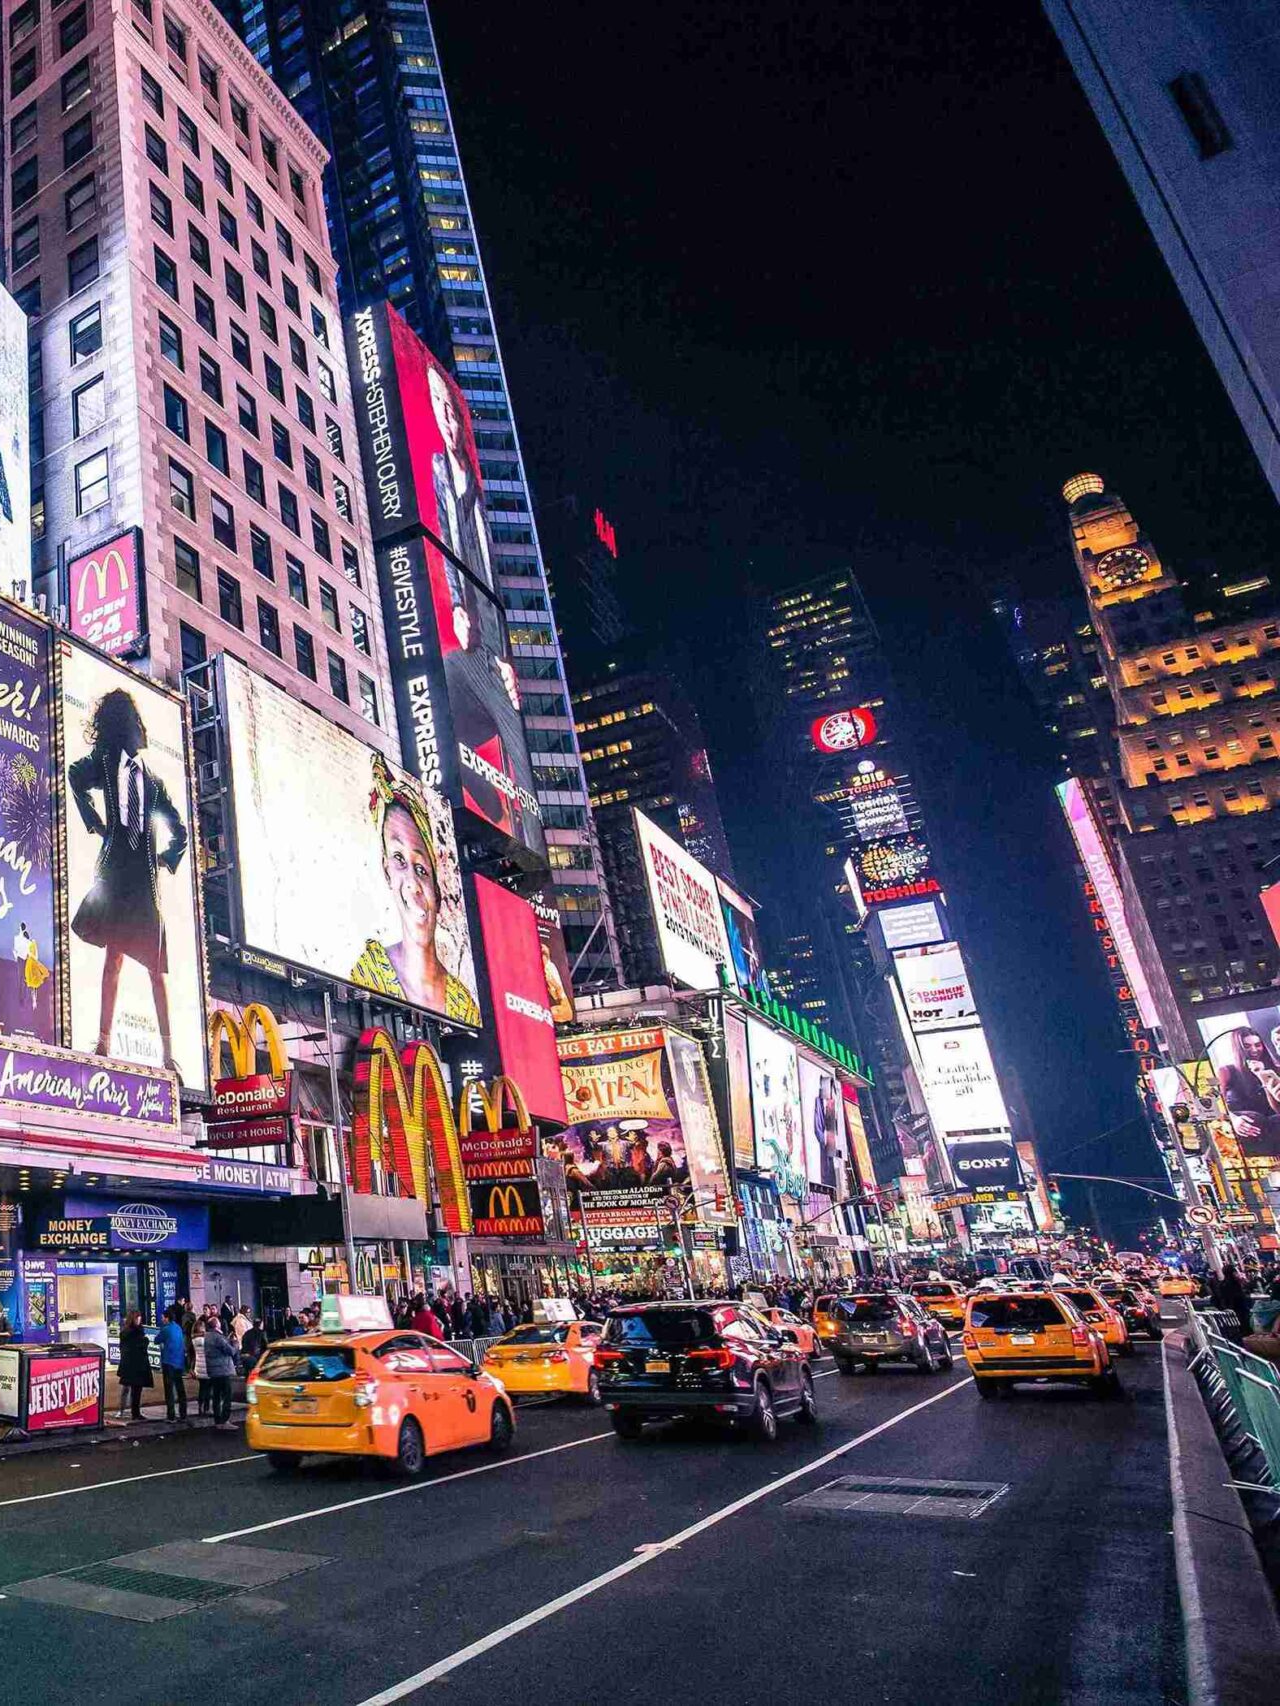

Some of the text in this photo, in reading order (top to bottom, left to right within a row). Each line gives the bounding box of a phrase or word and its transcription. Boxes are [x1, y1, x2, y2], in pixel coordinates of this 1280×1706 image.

[377, 463, 403, 520] CURRY
[80, 596, 126, 626] OPEN
[389, 546, 425, 660] #GIVESTYLE
[86, 613, 122, 643] 24
[407, 674, 443, 788] EXPRESS
[849, 778, 896, 795] TOSHIBA
[864, 879, 942, 904] TOSHIBA
[1083, 882, 1119, 968] ERNST
[921, 984, 966, 998] DUNKIN'
[924, 992, 965, 1003] DONUTS
[912, 1008, 943, 1019] HOT
[585, 1031, 657, 1052] FAT HIT!
[88, 1071, 132, 1116] Paris
[216, 1086, 286, 1106] cDonald's
[217, 1101, 272, 1115] Restaurant
[250, 1126, 282, 1138] HOURS
[461, 1136, 532, 1153] McDonald's
[958, 1157, 1010, 1171] SONY
[214, 1164, 290, 1188] MONEY ATM
[975, 1184, 1006, 1194] SONY
[596, 1200, 617, 1208] BOOK
[48, 1219, 93, 1232] MONEY
[137, 1217, 178, 1231] EXCHANGE
[40, 1232, 108, 1245] EXCHANGE
[148, 1261, 157, 1298] MONEY
[28, 1369, 100, 1416] JERSEY BOYS
